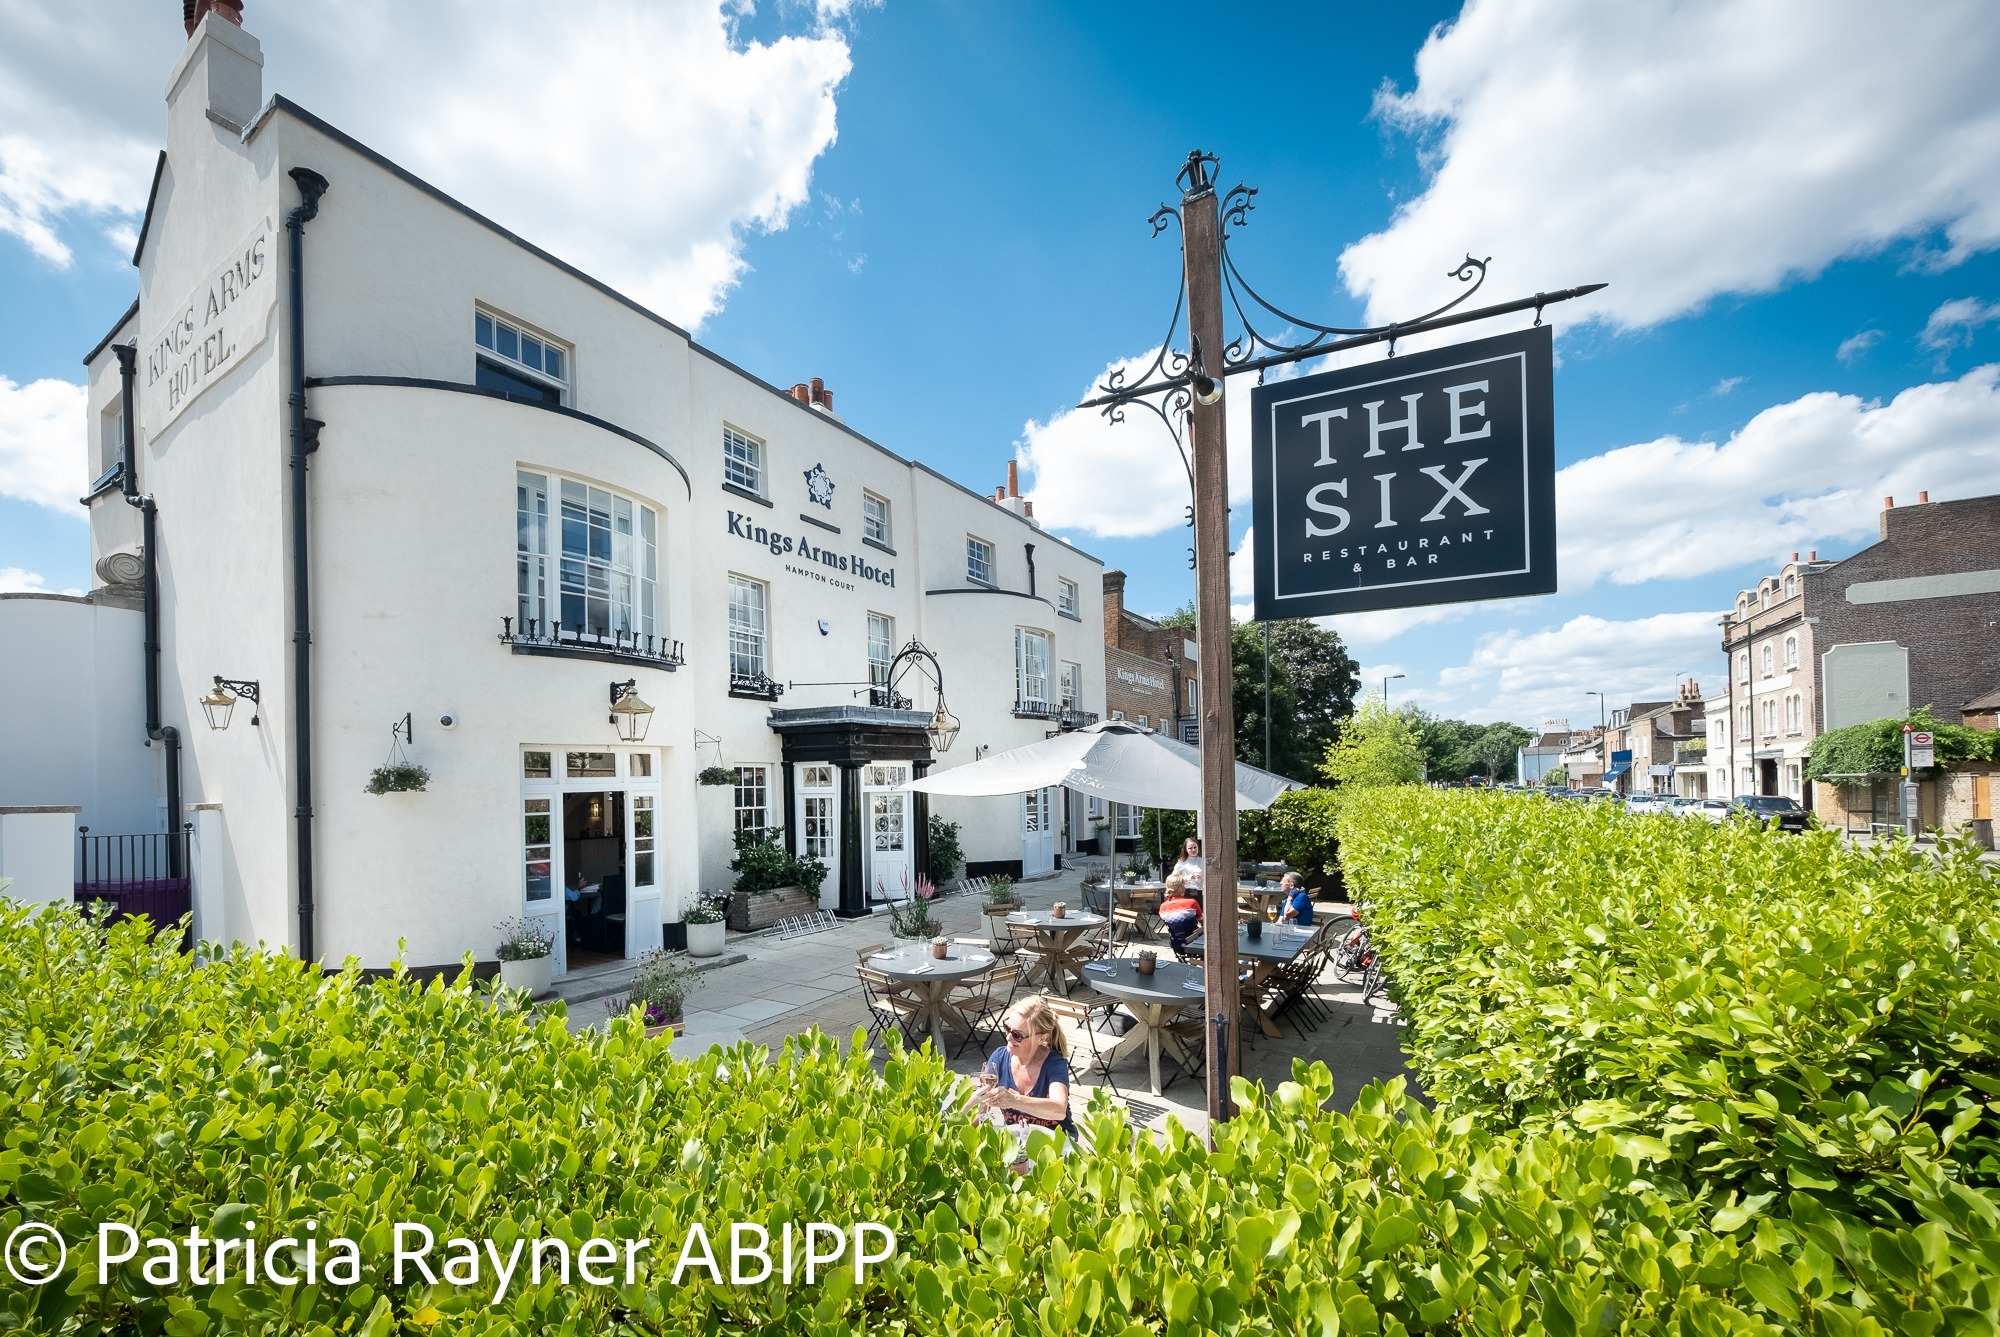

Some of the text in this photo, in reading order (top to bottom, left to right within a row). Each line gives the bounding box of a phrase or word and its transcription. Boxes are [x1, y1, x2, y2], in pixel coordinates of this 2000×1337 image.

[148, 234, 265, 387] KINGS ARMS
[168, 326, 236, 412] HOTEL.
[1301, 379, 1492, 467] THE
[1305, 457, 1491, 539] SIX
[727, 510, 896, 588] Kings Arms Hotel
[785, 564, 855, 592] HAMPTON COURT
[1303, 529, 1495, 563] RESTAURANT
[1352, 553, 1439, 573] & BAR
